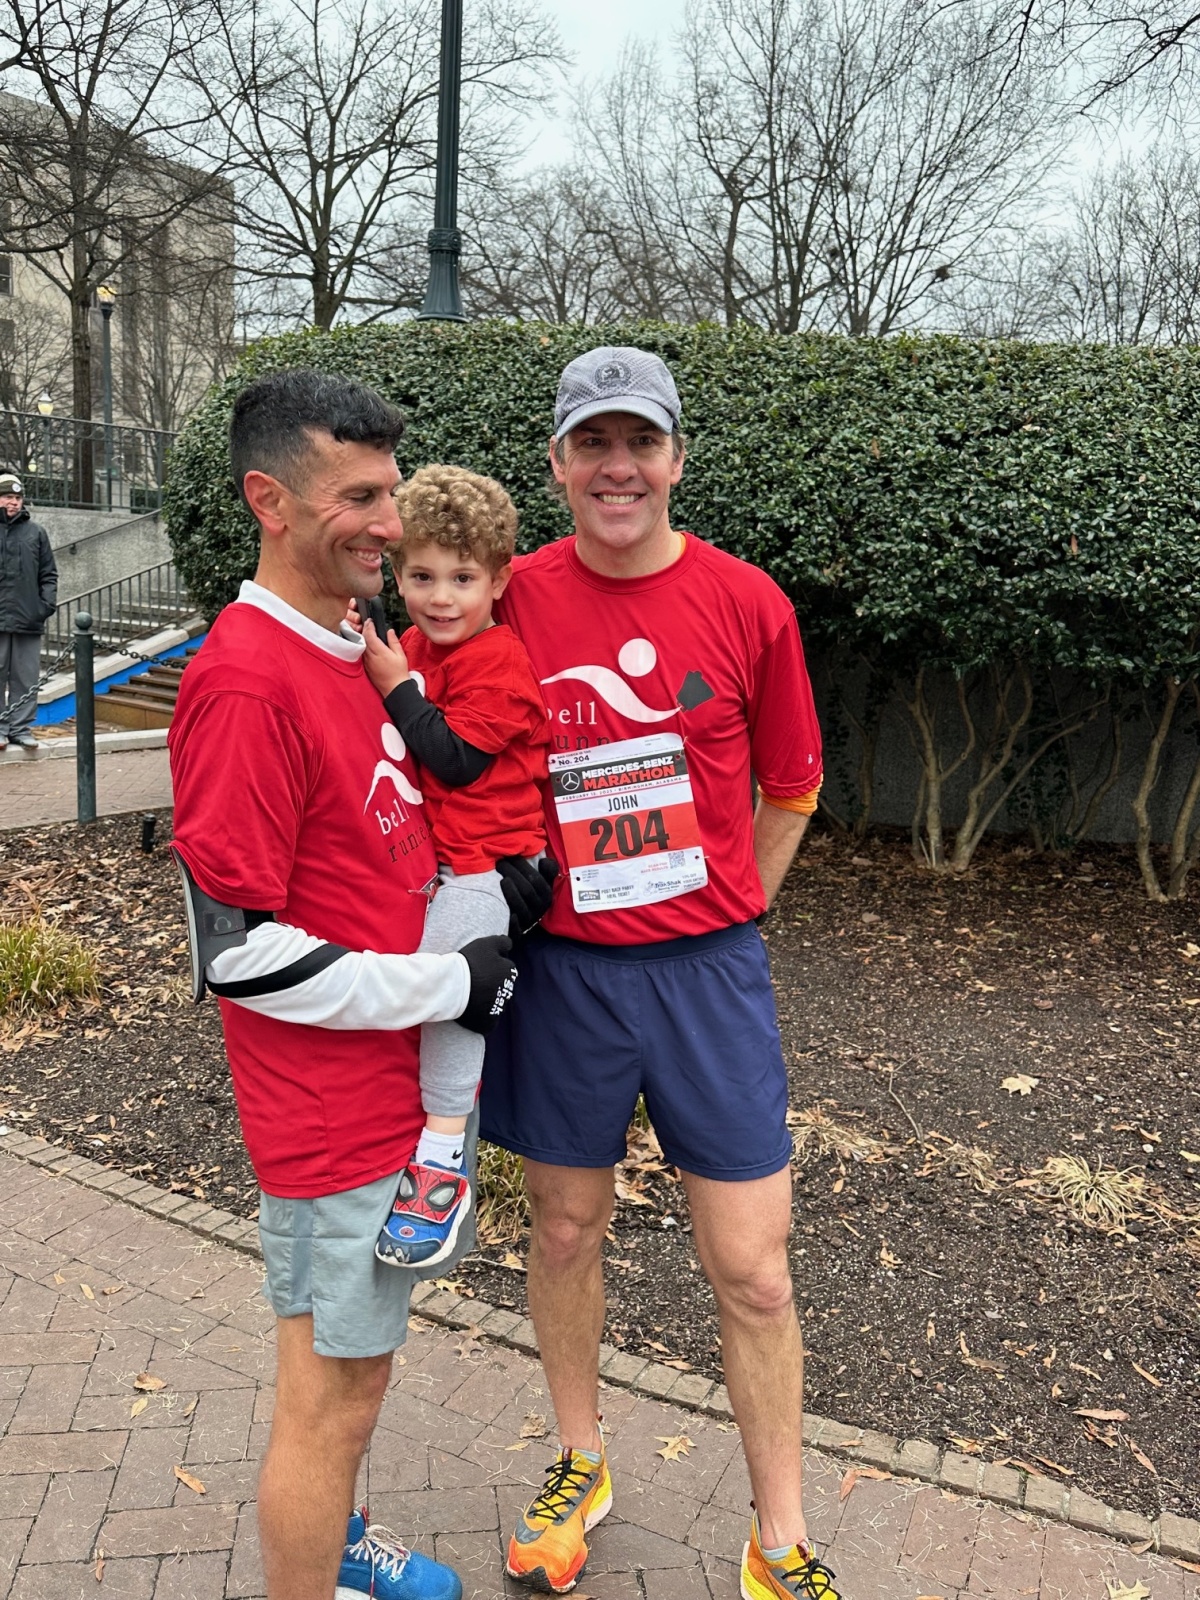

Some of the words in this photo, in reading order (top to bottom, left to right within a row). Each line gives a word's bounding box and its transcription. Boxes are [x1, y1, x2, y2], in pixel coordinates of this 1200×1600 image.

[573, 755, 590, 763] 204
[581, 755, 674, 779] MERCEDES-BENZ
[562, 793, 589, 801] FEBRUARY
[656, 777, 682, 785] ALABAMA
[583, 764, 676, 791] MARATHON
[608, 794, 639, 812] JOHN
[375, 796, 410, 835] bell
[589, 809, 670, 862] 204
